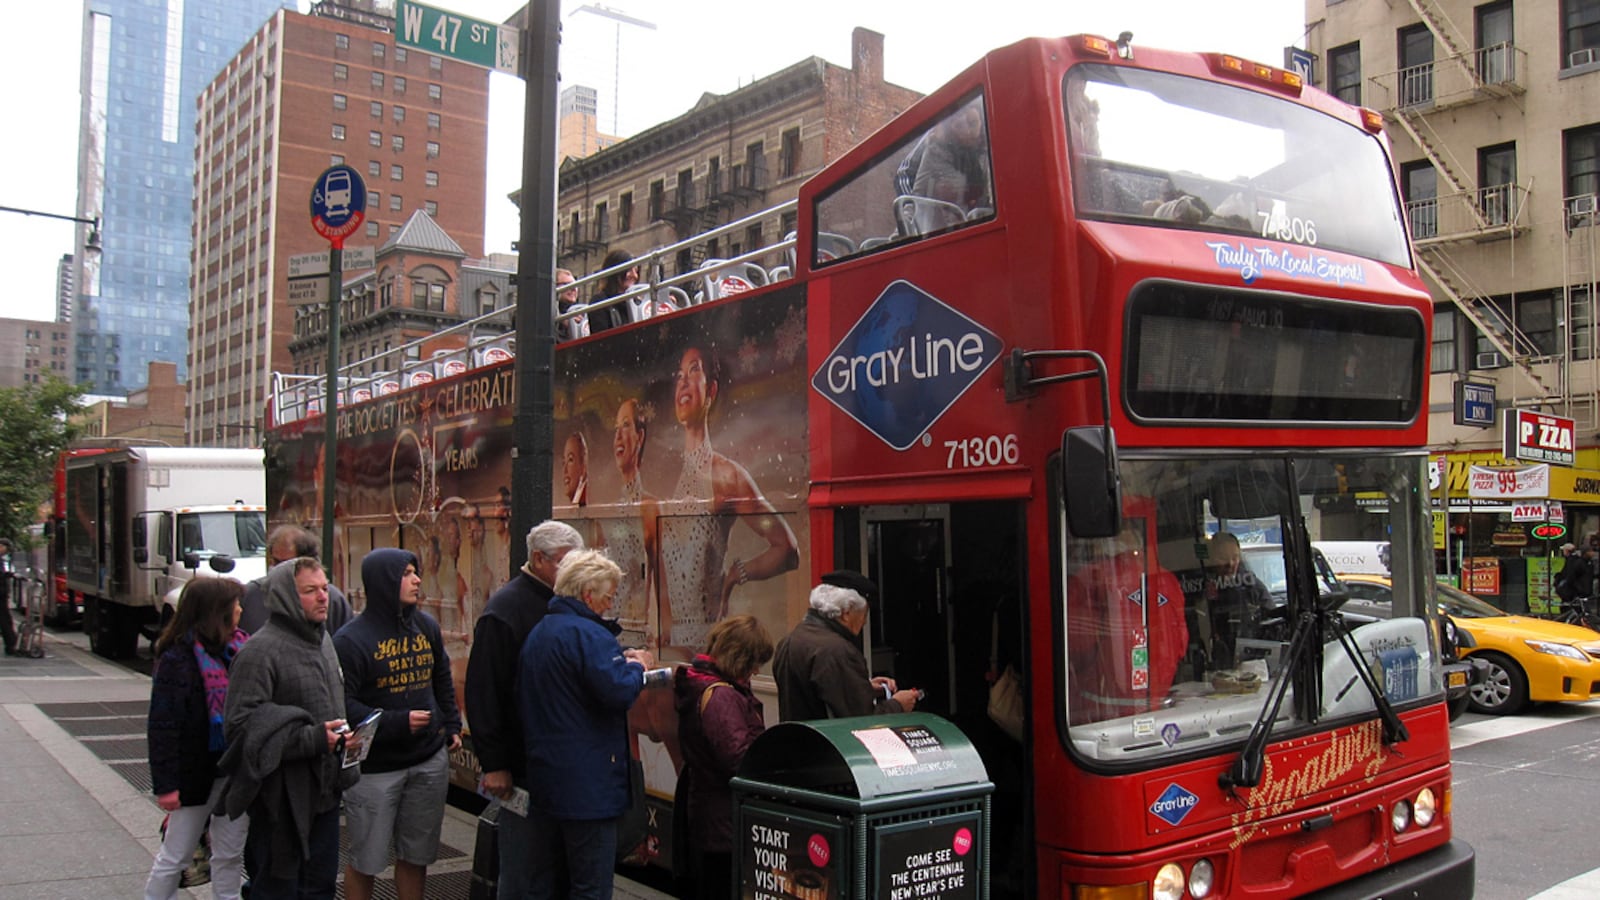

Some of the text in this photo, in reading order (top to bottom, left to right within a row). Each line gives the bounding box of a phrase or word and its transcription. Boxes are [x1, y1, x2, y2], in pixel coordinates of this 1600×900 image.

[404, 3, 490, 53] W 47 ST
[325, 215, 360, 236] STANDING
[1205, 241, 1363, 284] Truly, The Local Expert!
[910, 332, 984, 378] Line
[355, 394, 417, 436] ROCKETTES
[436, 368, 516, 420] CELEBRATI
[1473, 406, 1487, 419] INN
[445, 447, 479, 472] YEARS
[944, 434, 1020, 469] 71306
[1472, 473, 1494, 481] FRESH
[1473, 481, 1494, 489] PIZZA
[1513, 506, 1543, 516] ATM
[902, 730, 929, 739] TIMES
[906, 737, 939, 748] SQUARE
[752, 824, 790, 849] START
[956, 836, 970, 848] FREE!
[754, 847, 788, 872] YOUR
[810, 841, 828, 861] FREE!
[906, 849, 952, 869] COME SEE
[755, 869, 786, 894] VISIT
[891, 861, 965, 886] THE CENTENNIAL
[891, 875, 965, 900] NEW YEAR'S EVE
